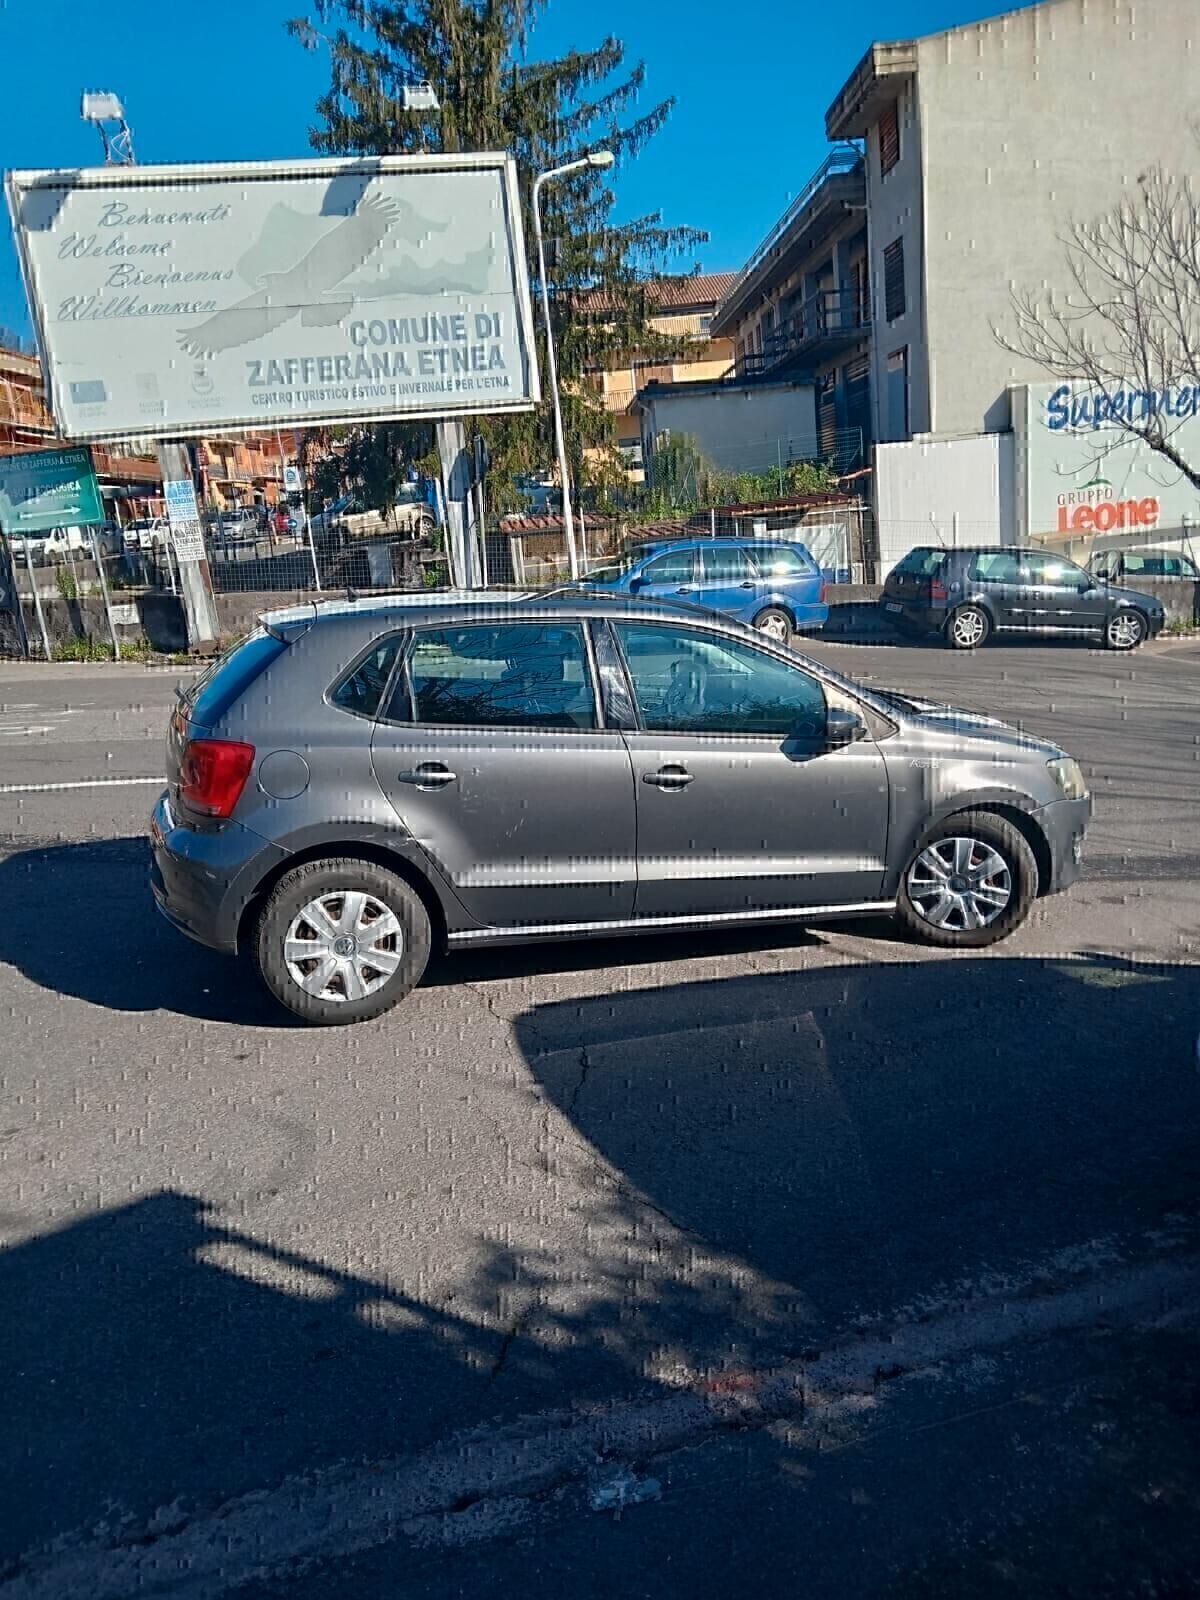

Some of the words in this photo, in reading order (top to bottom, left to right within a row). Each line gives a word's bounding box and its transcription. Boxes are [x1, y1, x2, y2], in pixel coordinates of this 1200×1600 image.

[58, 234, 172, 260] Welcome
[58, 295, 217, 320] Willkommen
[350, 314, 467, 346] COMUNE
[474, 311, 501, 339] DI
[246, 351, 412, 387] ZAFFERANA
[418, 344, 507, 376] ETNEA
[252, 391, 293, 405] CENTRO
[296, 387, 348, 402] TURISTICO
[352, 384, 387, 399] ESTIVO
[390, 384, 396, 396] E
[399, 379, 453, 395] INVERNALE
[455, 378, 474, 391] PER
[476, 375, 510, 389] L'ETNA
[1057, 488, 1113, 506] GRUPPO
